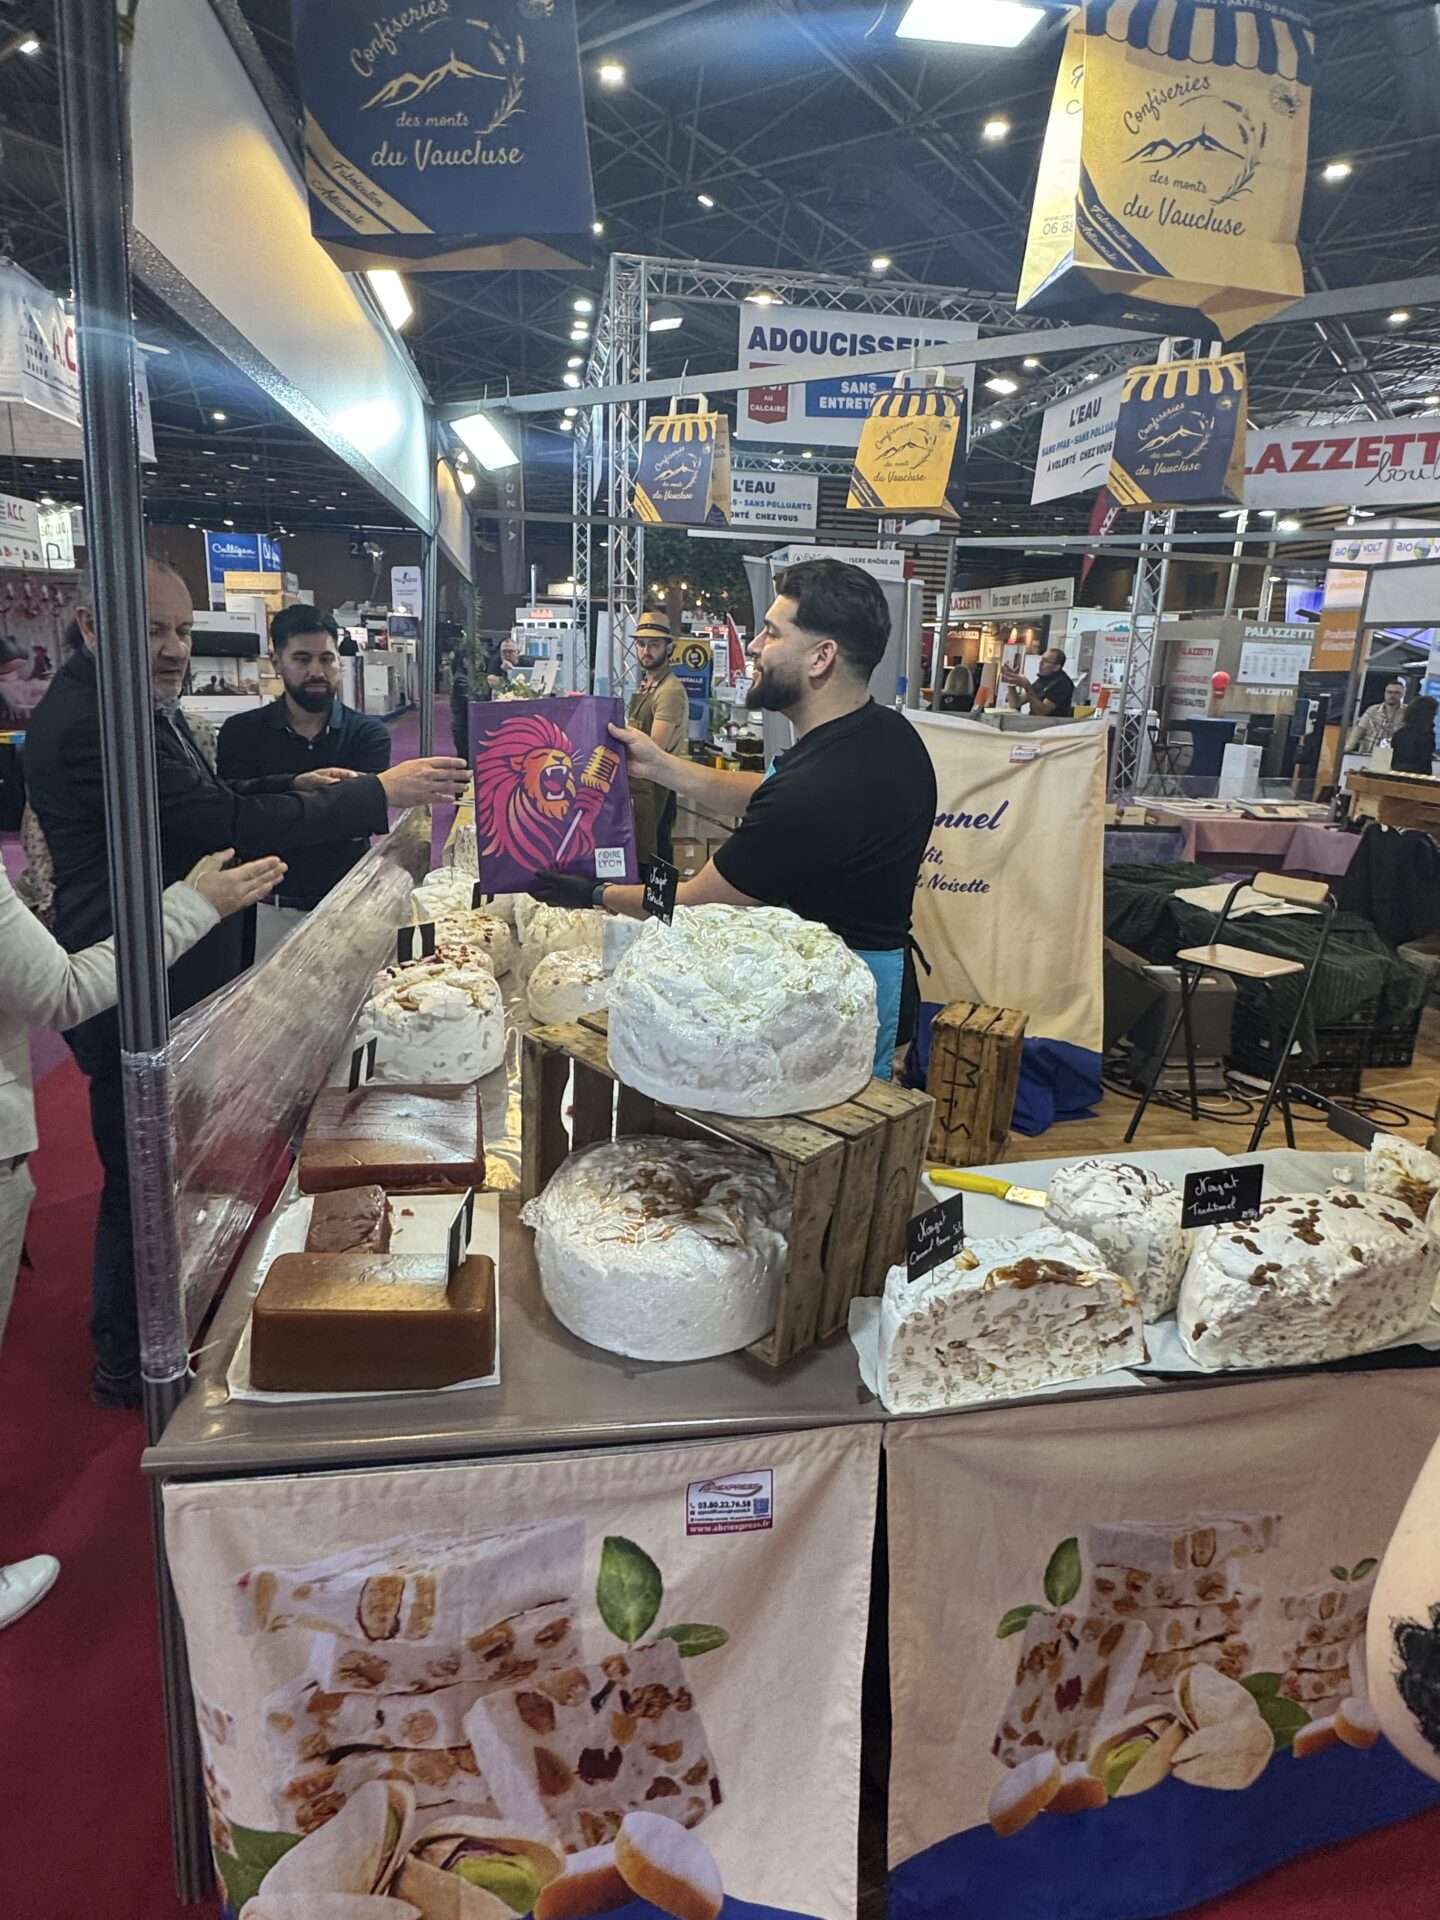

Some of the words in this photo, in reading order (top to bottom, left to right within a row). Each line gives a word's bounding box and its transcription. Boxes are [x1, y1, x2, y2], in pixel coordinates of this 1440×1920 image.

[351, 0, 448, 77] Confiseries
[1123, 75, 1211, 135] Confiseries
[396, 112, 420, 127] des
[425, 111, 469, 127] monts
[371, 141, 406, 166] du
[414, 139, 524, 171] Vaucluse
[1150, 170, 1169, 185] des
[1173, 179, 1207, 194] monts
[1123, 194, 1153, 219] du
[1159, 197, 1246, 236] Vaucluse
[840, 381, 877, 394] SANS
[750, 404, 786, 413] CALCAIRE
[1069, 397, 1102, 427] L'EAU
[1079, 447, 1095, 461] CHEZ
[1097, 441, 1112, 455] VOUS
[1154, 461, 1201, 476] Vaucluse
[733, 480, 776, 495] L'EAU
[766, 501, 812, 511] POLLUANTS
[755, 512, 776, 521] CHEZ
[777, 513, 799, 522] VOUS
[212, 544, 256, 557] Culligan
[1245, 627, 1315, 639] PALAZZETTI
[598, 850, 621, 859] FOIRE
[598, 860, 622, 868] LYON
[927, 872, 991, 894] Noisette
[1194, 1173, 1240, 1196] Nougat
[917, 1208, 946, 1242] Nougat
